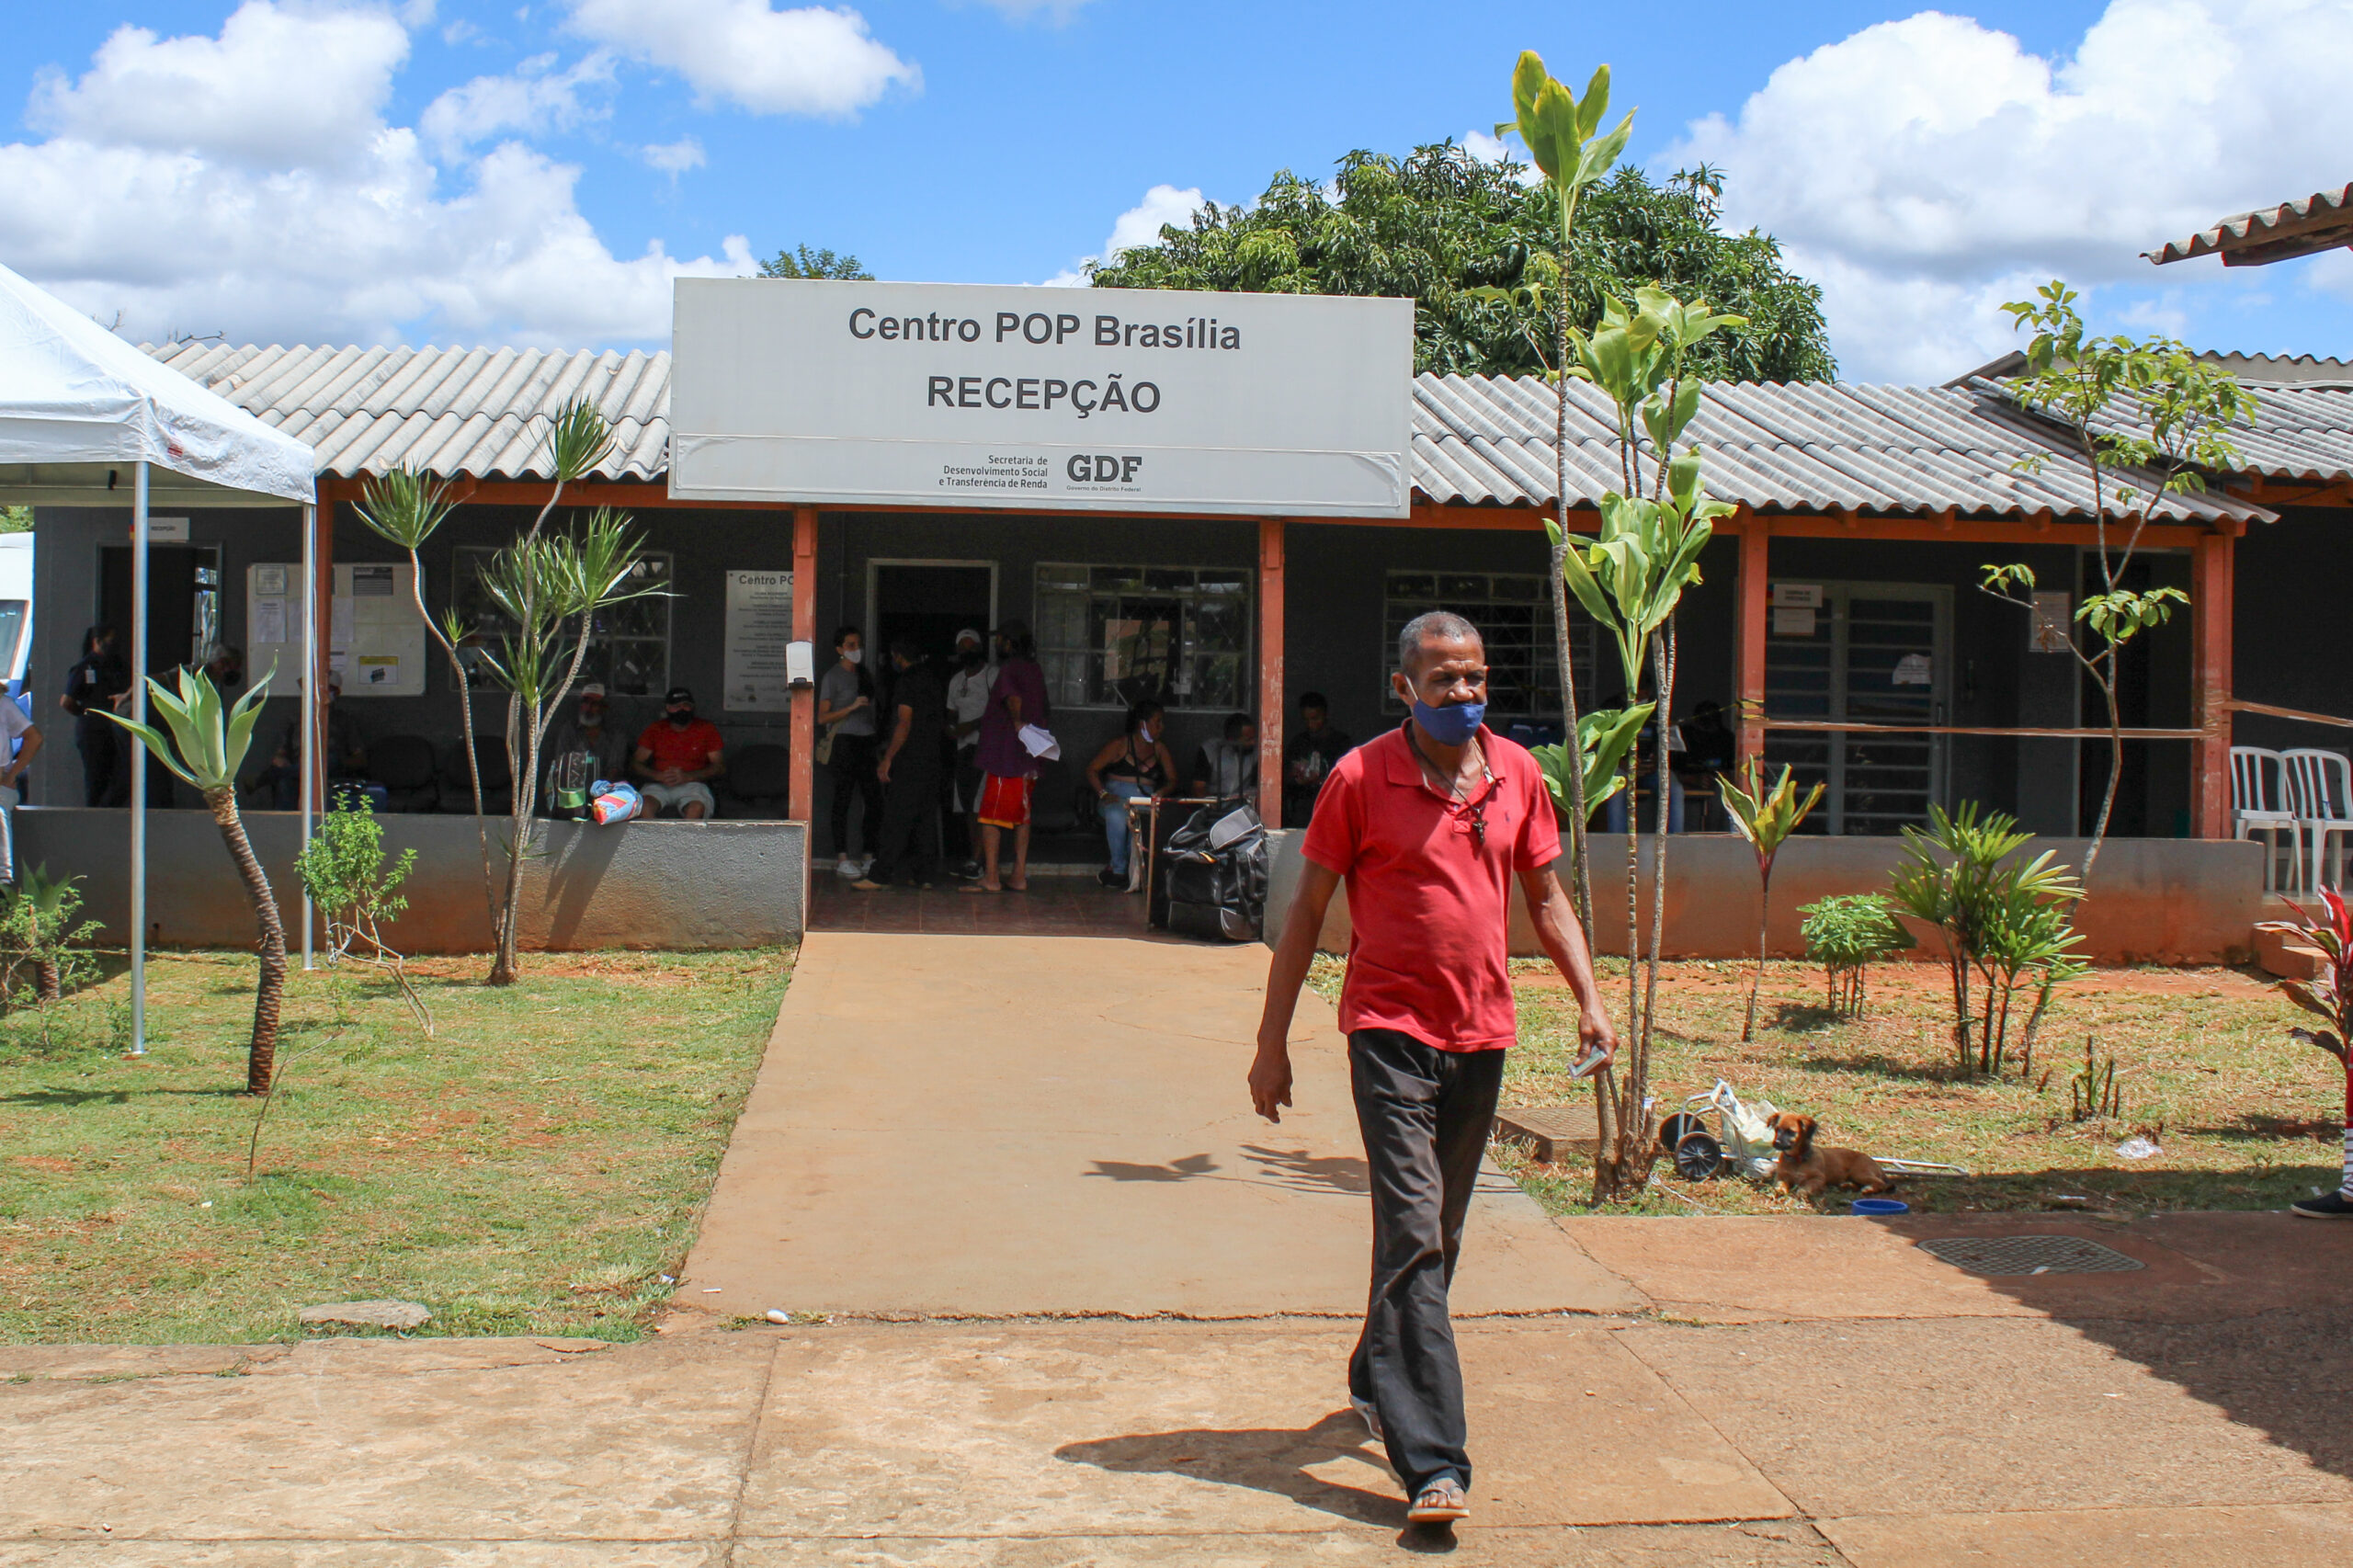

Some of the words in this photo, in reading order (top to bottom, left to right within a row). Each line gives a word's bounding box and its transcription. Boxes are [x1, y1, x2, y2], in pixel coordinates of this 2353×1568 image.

[848, 307, 982, 343] Centro
[995, 312, 1081, 345] POP
[1094, 314, 1241, 350] Brasília
[927, 373, 1161, 419] RECEPÇÃO
[988, 454, 1034, 465] Secretaria
[1037, 456, 1048, 466] de
[943, 465, 1020, 476] Desenvolvimento
[1021, 467, 1048, 477] Social
[1066, 454, 1142, 483] GDF
[938, 478, 945, 486] e
[947, 476, 1006, 487] Transferência
[1007, 478, 1019, 488] de
[1020, 479, 1048, 489] Renda
[738, 574, 777, 585] Centro
